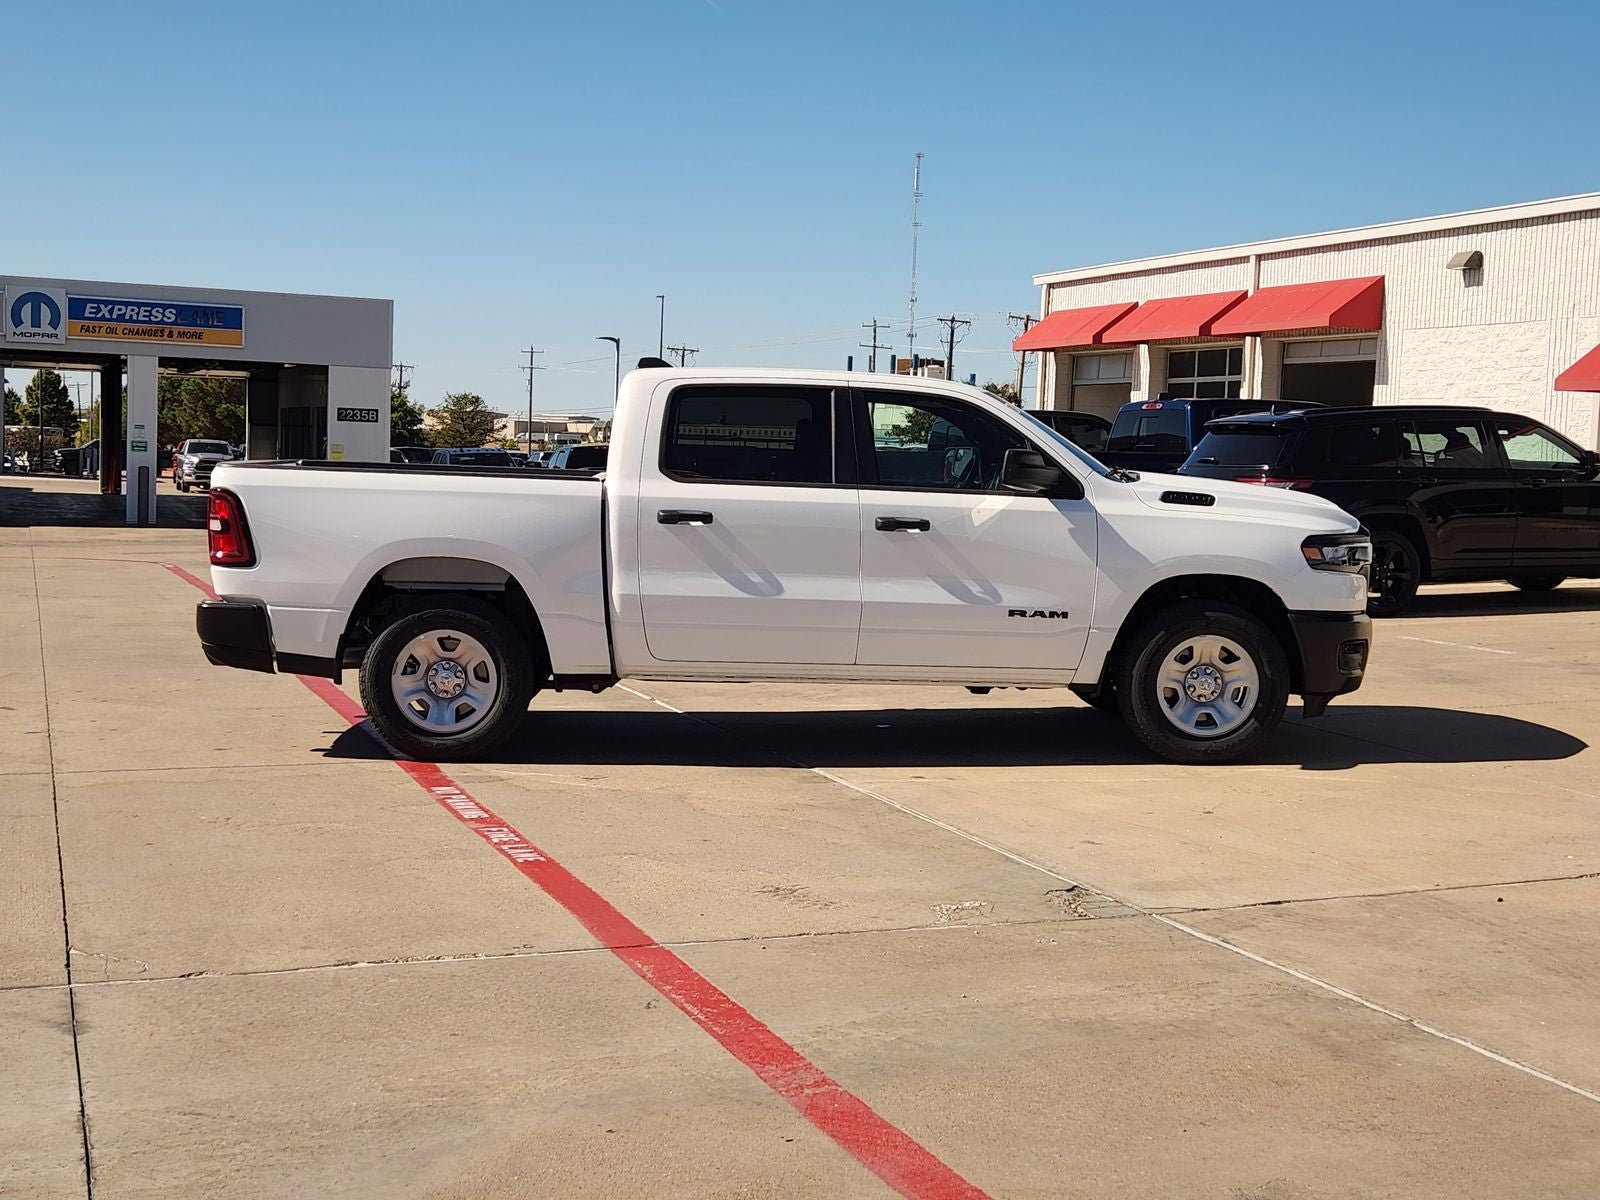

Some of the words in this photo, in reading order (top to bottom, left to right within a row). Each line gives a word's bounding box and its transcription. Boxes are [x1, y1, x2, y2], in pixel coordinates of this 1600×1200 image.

[84, 303, 177, 323] EXPRESS
[12, 331, 59, 340] MOPAR
[79, 324, 104, 335] FAST
[105, 327, 119, 336] OIL
[121, 327, 165, 339] CHANGES
[166, 330, 174, 339] &
[176, 330, 204, 340] MORE
[338, 409, 377, 421] 2235B
[1008, 609, 1069, 619] RAM
[479, 827, 521, 844] FIRE
[499, 843, 547, 863] LANE
